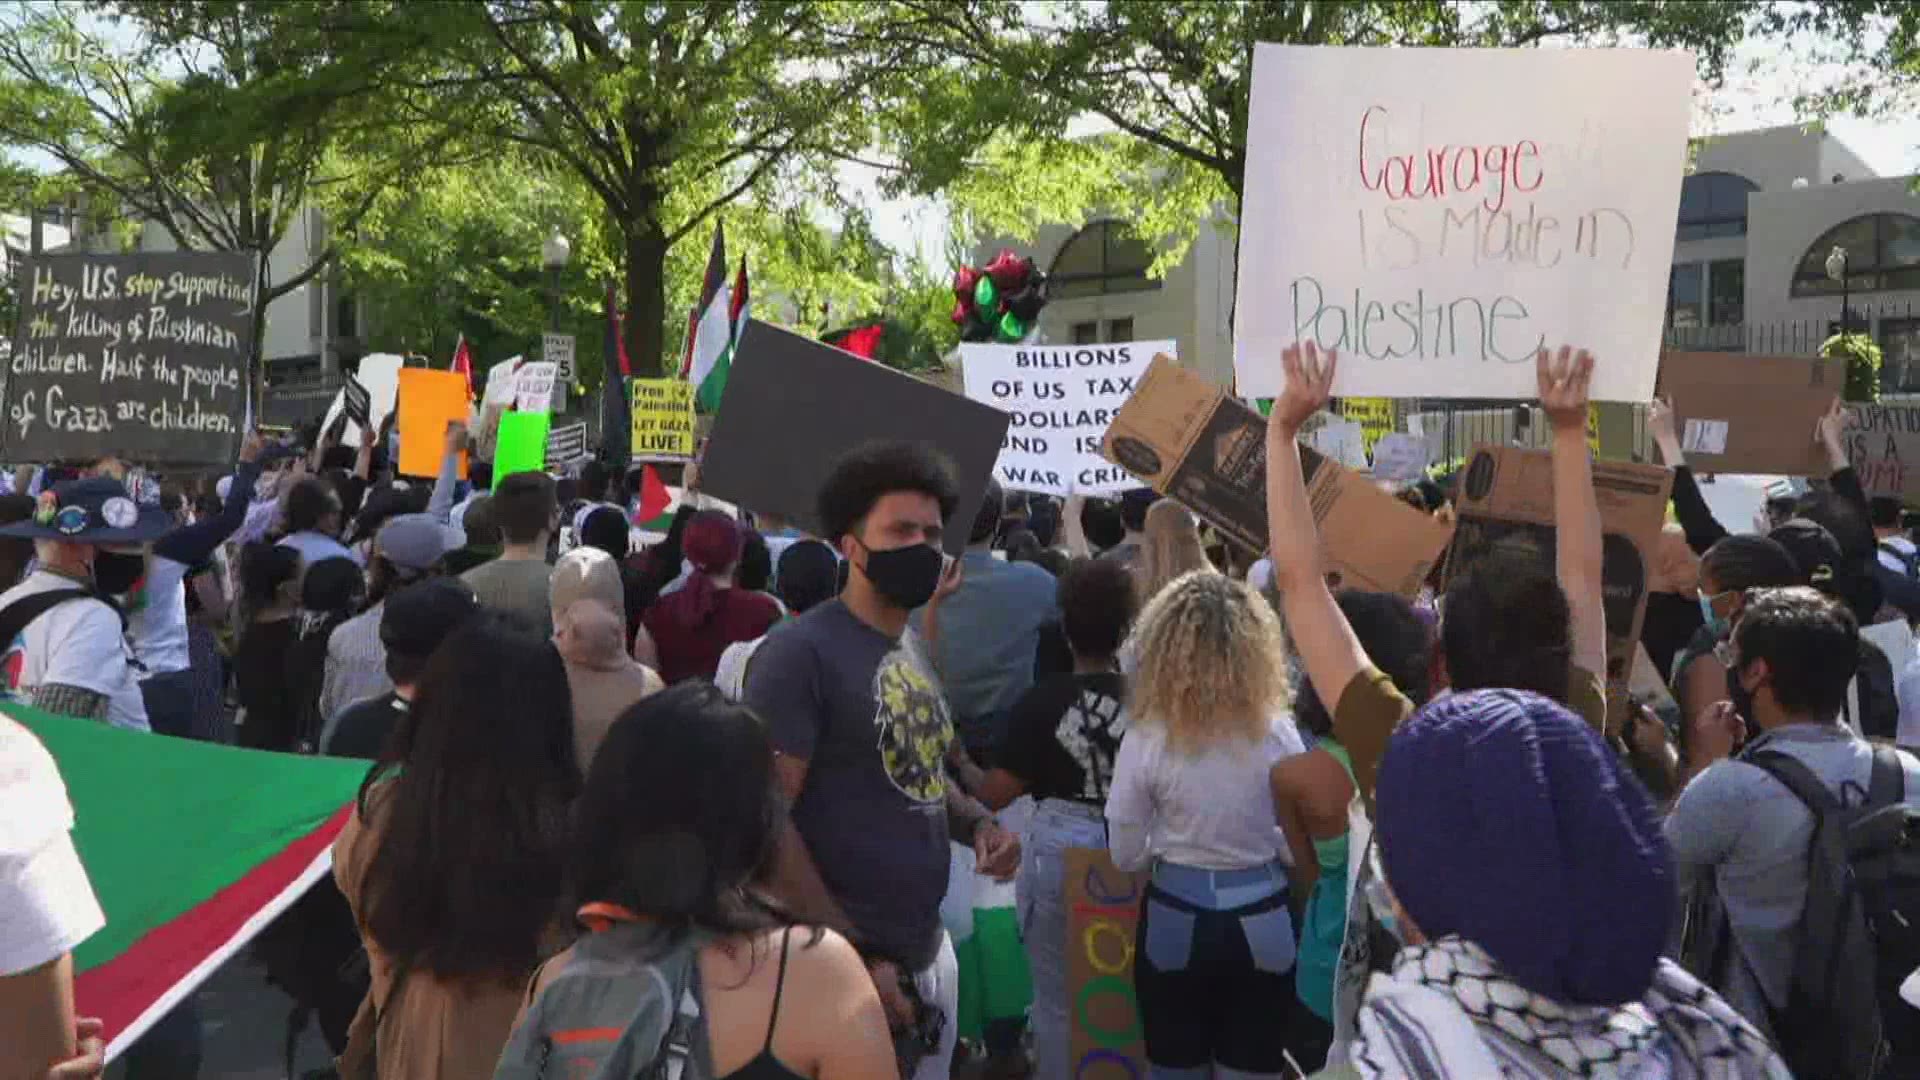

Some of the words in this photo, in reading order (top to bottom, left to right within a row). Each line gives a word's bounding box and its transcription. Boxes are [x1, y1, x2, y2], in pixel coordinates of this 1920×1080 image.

[1358, 104, 1545, 214] Courage
[124, 271, 164, 303] stop
[30, 306, 58, 338] the
[127, 313, 145, 343] of
[1290, 275, 1545, 363] Palestine
[101, 348, 147, 384] Half
[152, 354, 178, 384] the
[182, 362, 240, 400] people
[1015, 347, 1132, 369] BILLIONS
[991, 380, 1024, 398] OF
[1033, 382, 1066, 399] US
[1085, 376, 1135, 397] TAX
[10, 389, 36, 440] of
[45, 384, 112, 432] Gaza
[116, 401, 146, 420] are
[150, 398, 236, 433] children.
[641, 434, 683, 450] LIVE!
[1884, 433, 1900, 461] A
[1001, 466, 1061, 486] WAR
